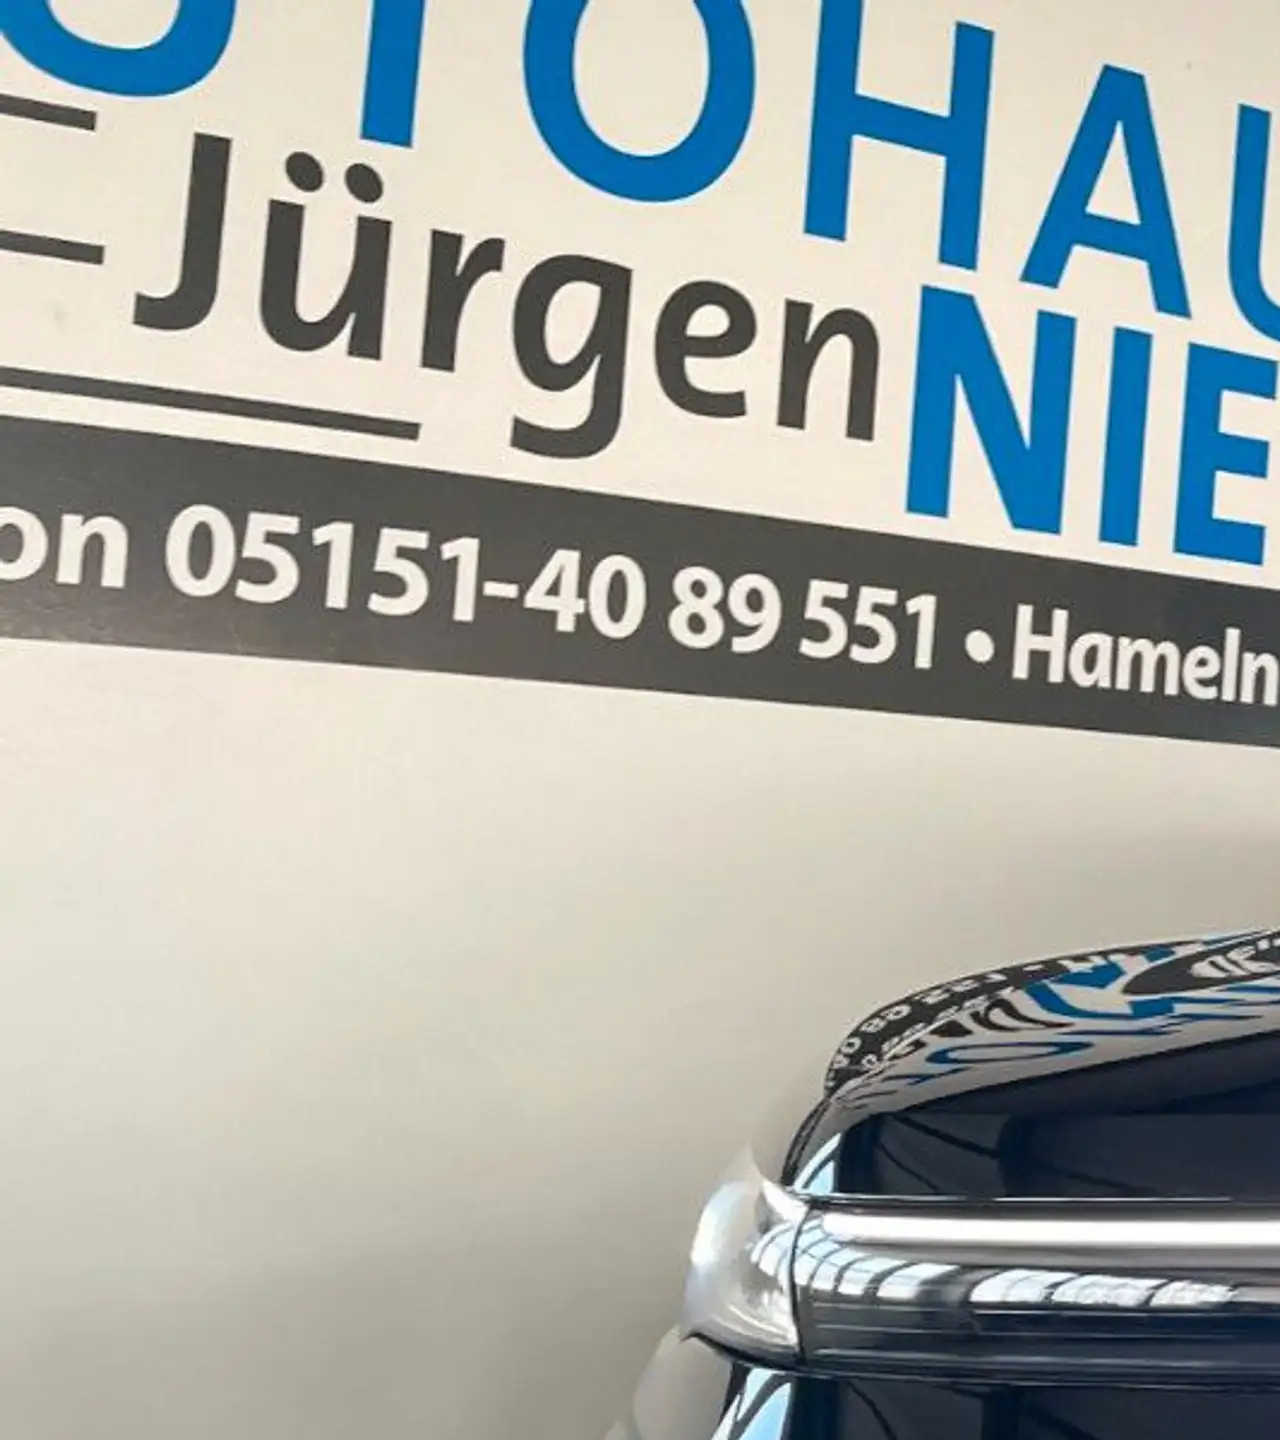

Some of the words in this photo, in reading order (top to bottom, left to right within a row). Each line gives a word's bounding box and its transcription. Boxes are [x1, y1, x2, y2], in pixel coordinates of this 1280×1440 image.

[133, 132, 880, 460] Jürgen
[165, 504, 647, 639] 05151-40
[668, 566, 782, 653] 89
[799, 579, 937, 670] 551
[1012, 604, 1280, 706] Hameln
